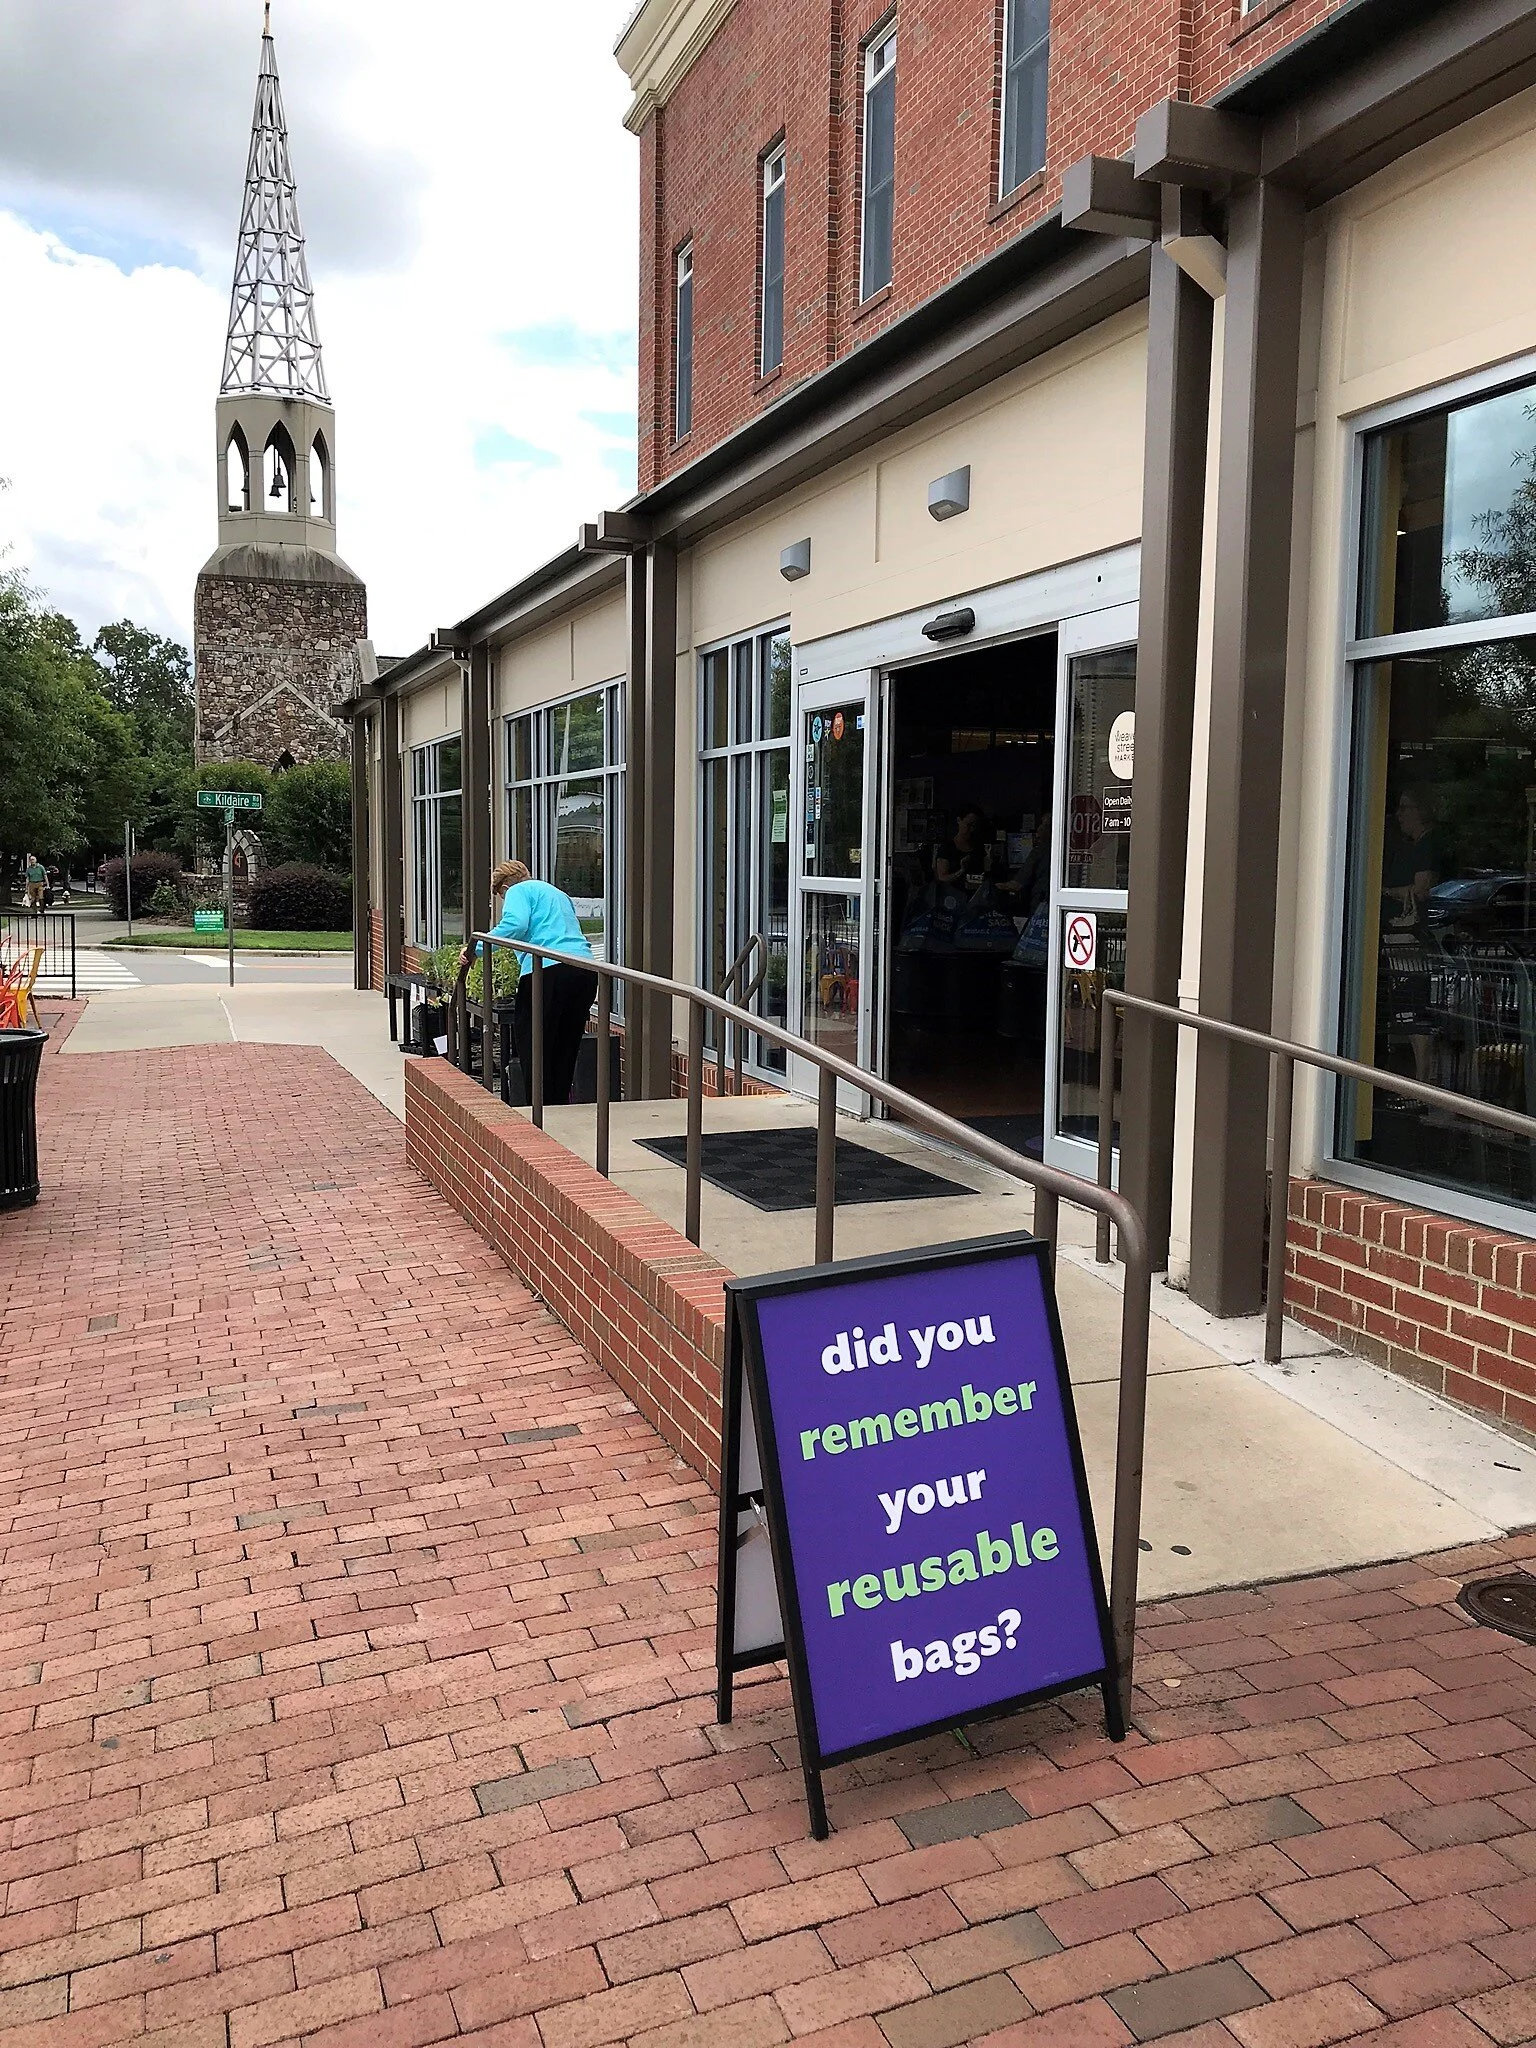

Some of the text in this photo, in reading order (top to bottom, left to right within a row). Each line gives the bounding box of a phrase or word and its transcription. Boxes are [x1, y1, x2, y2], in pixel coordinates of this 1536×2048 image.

[1115, 731, 1135, 742] weav
[1116, 743, 1135, 752] stree
[1115, 753, 1134, 761] MARKE
[215, 793, 250, 807] Kildaire
[1104, 797, 1119, 808] Open
[821, 1314, 997, 1375] did you
[799, 1380, 1038, 1461] remember
[877, 1466, 988, 1535] your
[826, 1521, 1061, 1619] reusable
[889, 1608, 1024, 1683] bags?
